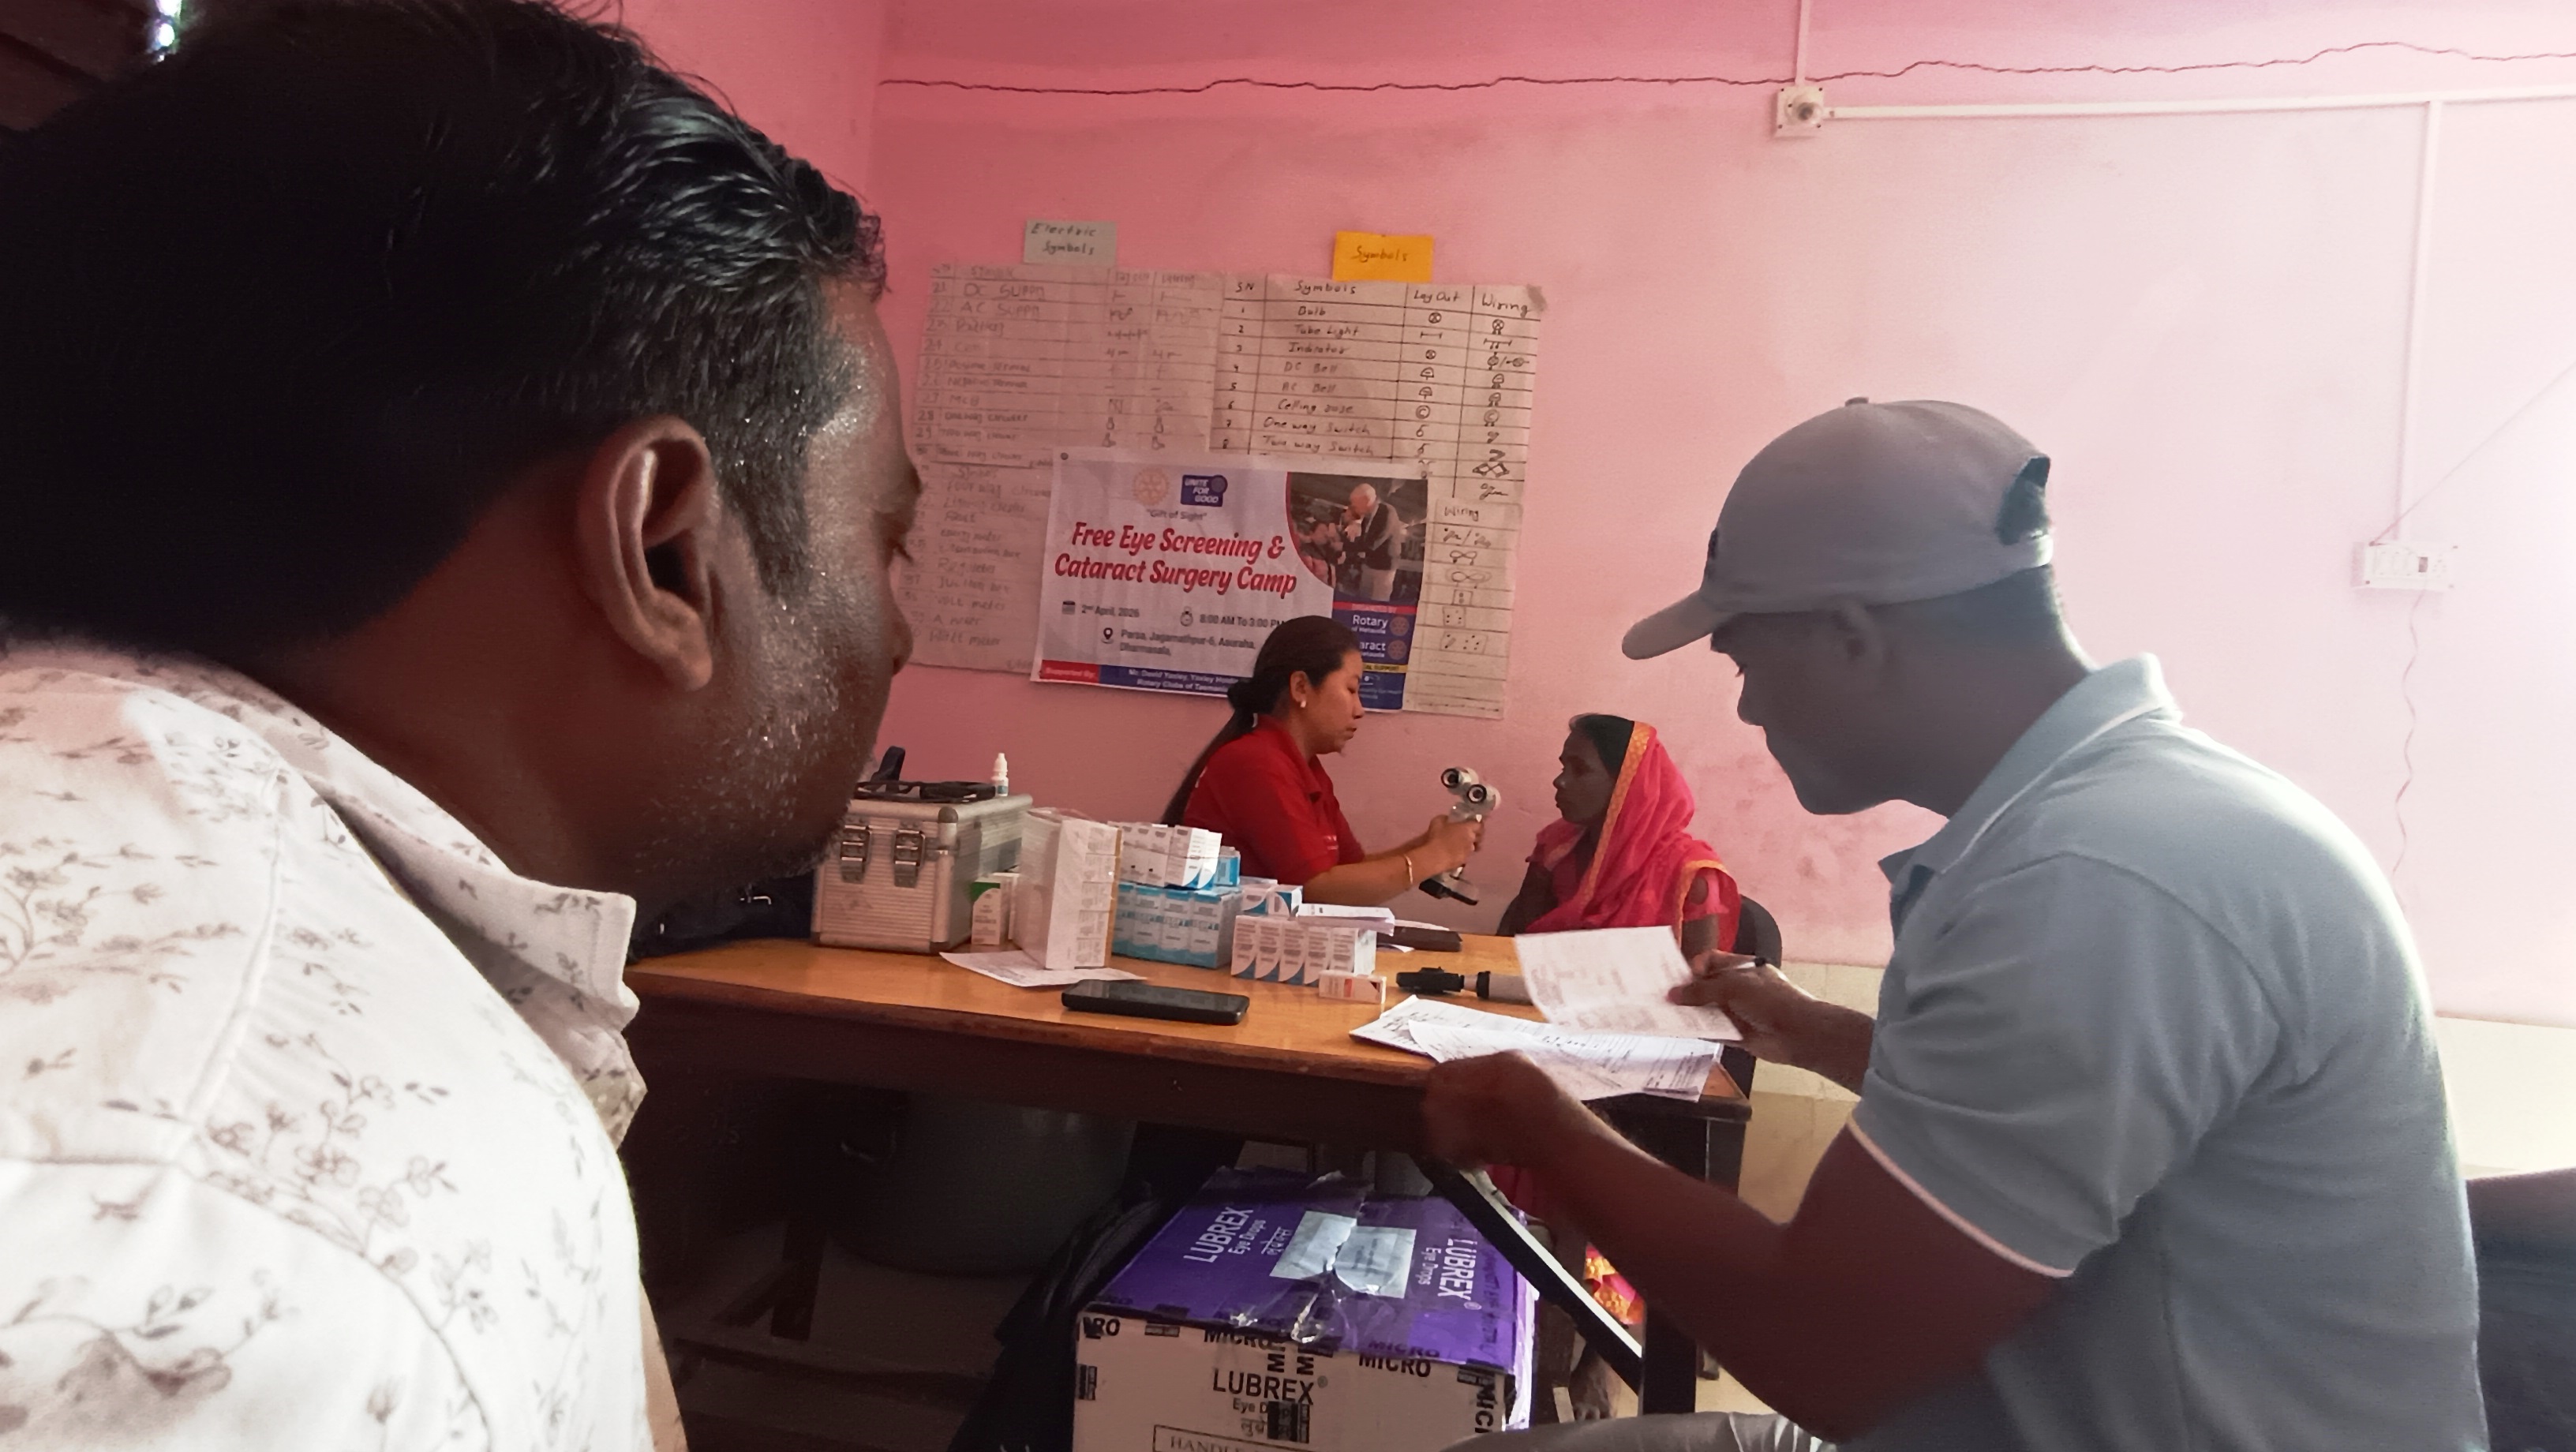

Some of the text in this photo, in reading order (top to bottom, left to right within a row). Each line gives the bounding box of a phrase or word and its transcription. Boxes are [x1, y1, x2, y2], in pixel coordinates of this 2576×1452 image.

[1043, 240, 1095, 255] Symbols
[1350, 245, 1408, 263] Symbols
[1294, 280, 1356, 295] Symbols
[1414, 290, 1459, 303] Lay Out
[1298, 305, 1326, 316] Bulb
[1481, 293, 1528, 318] Wiring
[1283, 361, 1339, 374] DC Bell
[1264, 416, 1371, 436] One way Switch
[1329, 440, 1373, 457] Switch
[1193, 486, 1210, 495] FOR
[1194, 495, 1219, 503] GOOD
[1445, 506, 1479, 522] Wiring
[1072, 522, 1286, 564] Free Eye Screening &
[1054, 553, 1297, 600] Cataract Surgery Camp
[1221, 616, 1235, 626] AM
[1237, 616, 1248, 626] To
[1353, 615, 1387, 629] Rotary
[1183, 1207, 1254, 1263] LUBREX
[1227, 1219, 1266, 1255] Eye Drops
[1415, 1247, 1442, 1285] Eye Drops
[1437, 1238, 1478, 1300] LUBREX
[1359, 1353, 1431, 1377] MICRO
[1212, 1368, 1314, 1405] LUBREX
[1233, 1398, 1256, 1414] Eye
